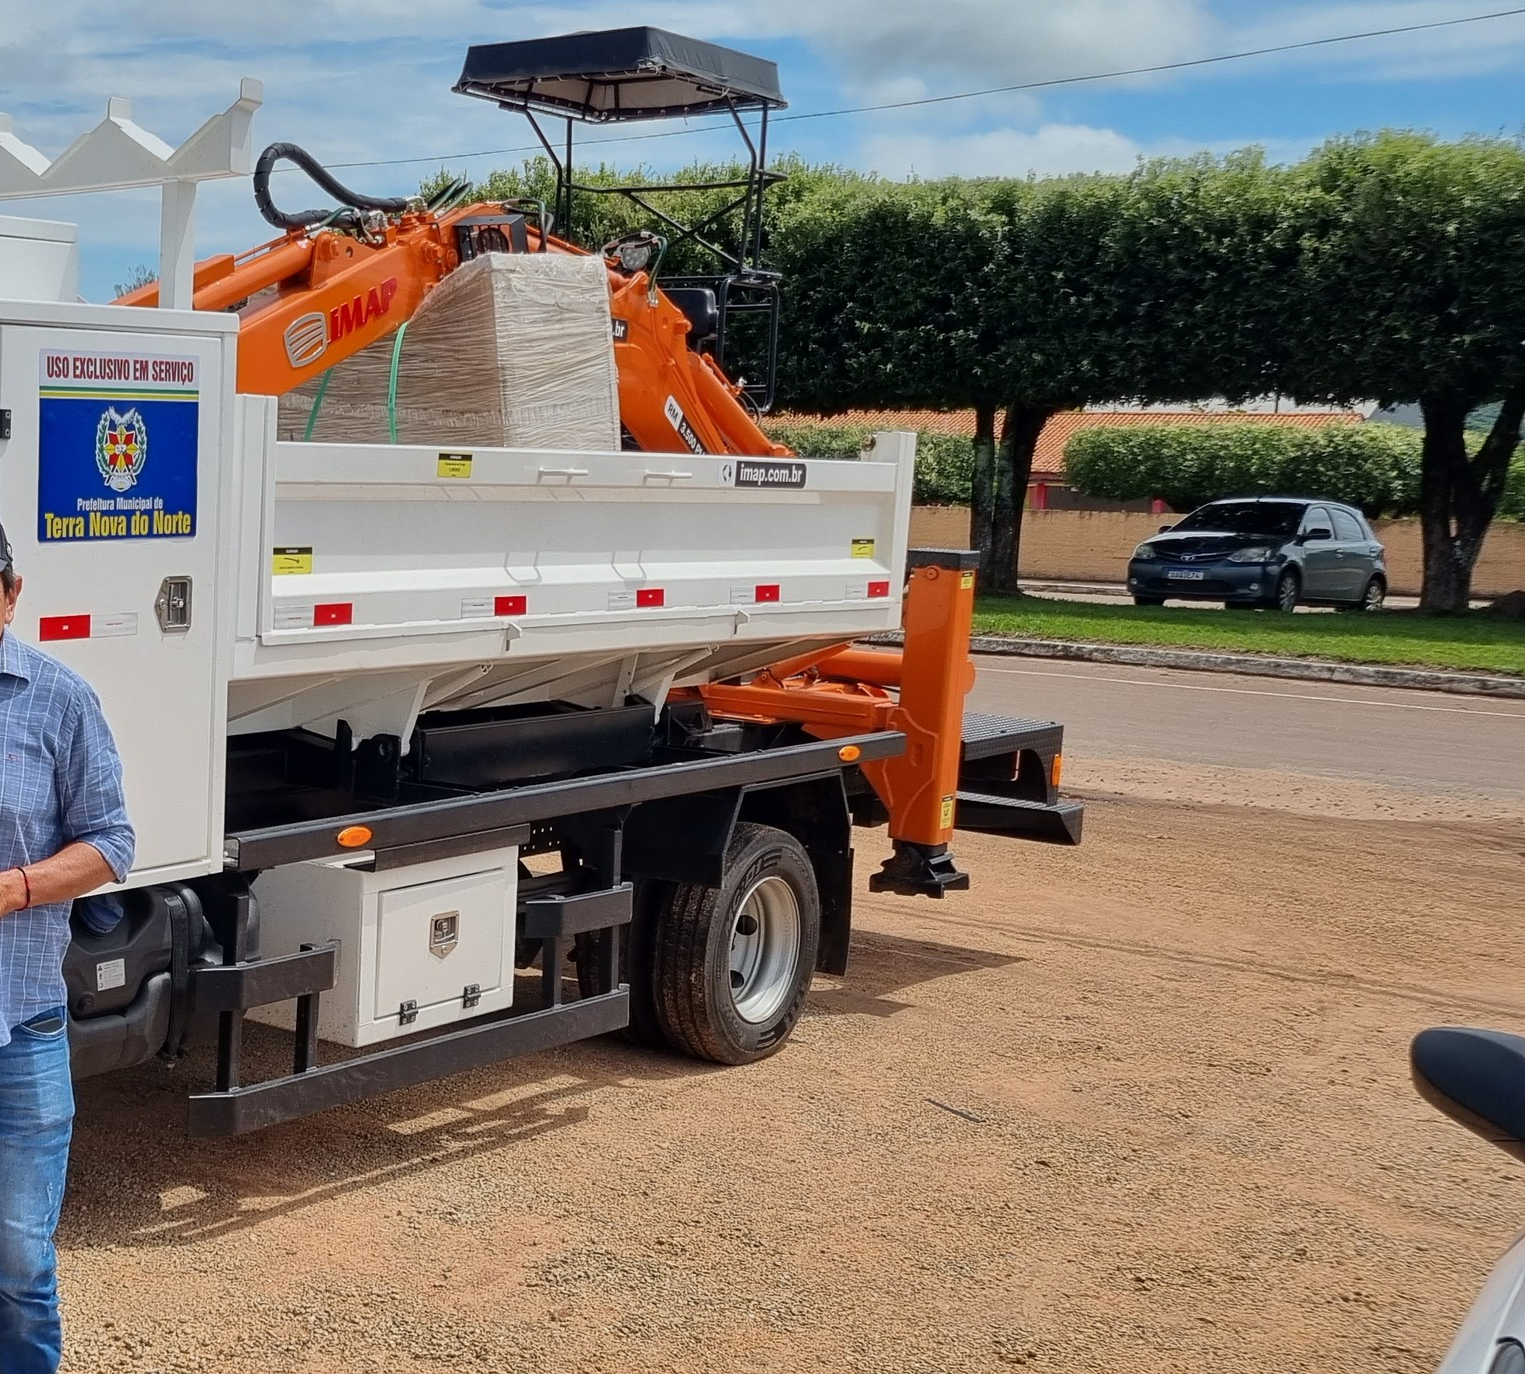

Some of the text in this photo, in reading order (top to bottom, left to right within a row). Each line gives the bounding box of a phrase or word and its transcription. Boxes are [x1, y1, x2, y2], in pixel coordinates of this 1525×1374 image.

[326, 276, 398, 345] IMAP
[46, 355, 194, 386] USO EXCLUSIVO EM SERVIÇO
[739, 463, 803, 486] imap.com.br
[76, 496, 164, 511] Prefeitura Municipal de
[44, 510, 192, 539] Terra Nova do Norte
